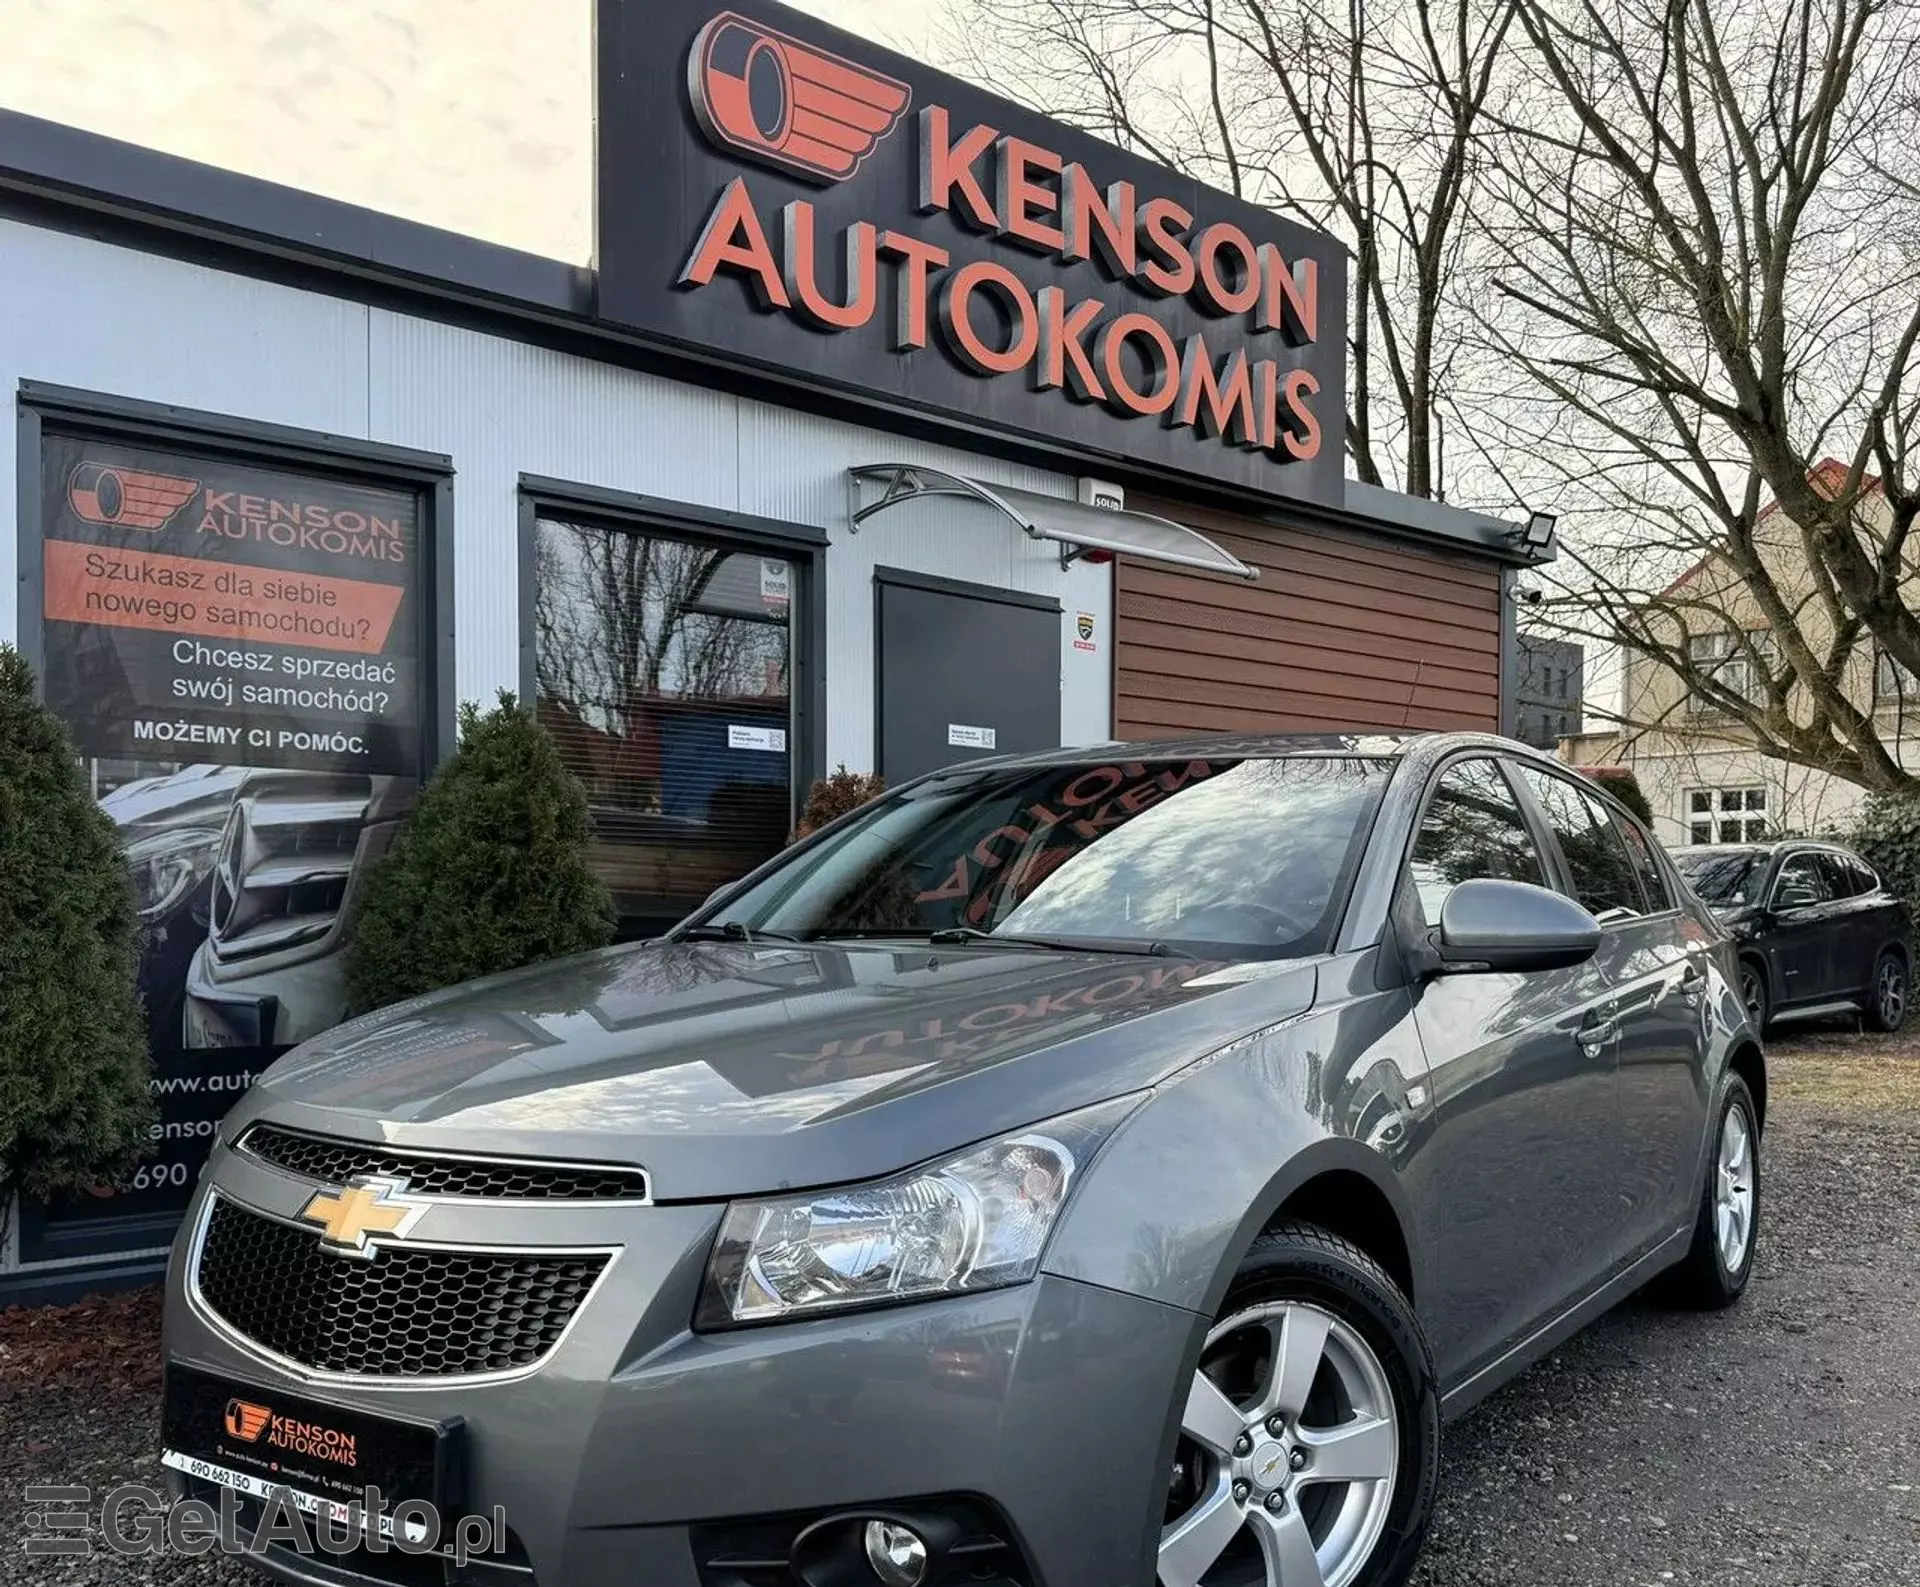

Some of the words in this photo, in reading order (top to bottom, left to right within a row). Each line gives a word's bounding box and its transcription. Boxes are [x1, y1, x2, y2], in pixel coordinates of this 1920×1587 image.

[920, 104, 1317, 345] KENSON
[678, 176, 1321, 460] AUTOKOMIS
[205, 488, 400, 540] KENSON
[1096, 497, 1119, 511] SOLID
[196, 512, 405, 563] AUTOKOMIS
[86, 553, 205, 591] Szukasz
[214, 571, 253, 596] dla
[263, 578, 337, 607] siebie
[86, 590, 197, 624] nowego
[207, 606, 371, 641] samochodu?
[173, 640, 273, 673] Chcesz
[282, 653, 396, 684] sprzedać
[172, 677, 233, 706] swój
[242, 683, 389, 714] samochód?
[134, 719, 241, 748] MOŻEMY
[249, 729, 272, 748] CI
[279, 729, 370, 755] POMÓC.
[133, 1162, 187, 1190] 690
[267, 1431, 357, 1467] AUTOKOMIS
[271, 1414, 356, 1449] KENSON
[190, 1460, 210, 1477] 690
[211, 1467, 231, 1484] 662
[231, 1474, 250, 1490] 150
